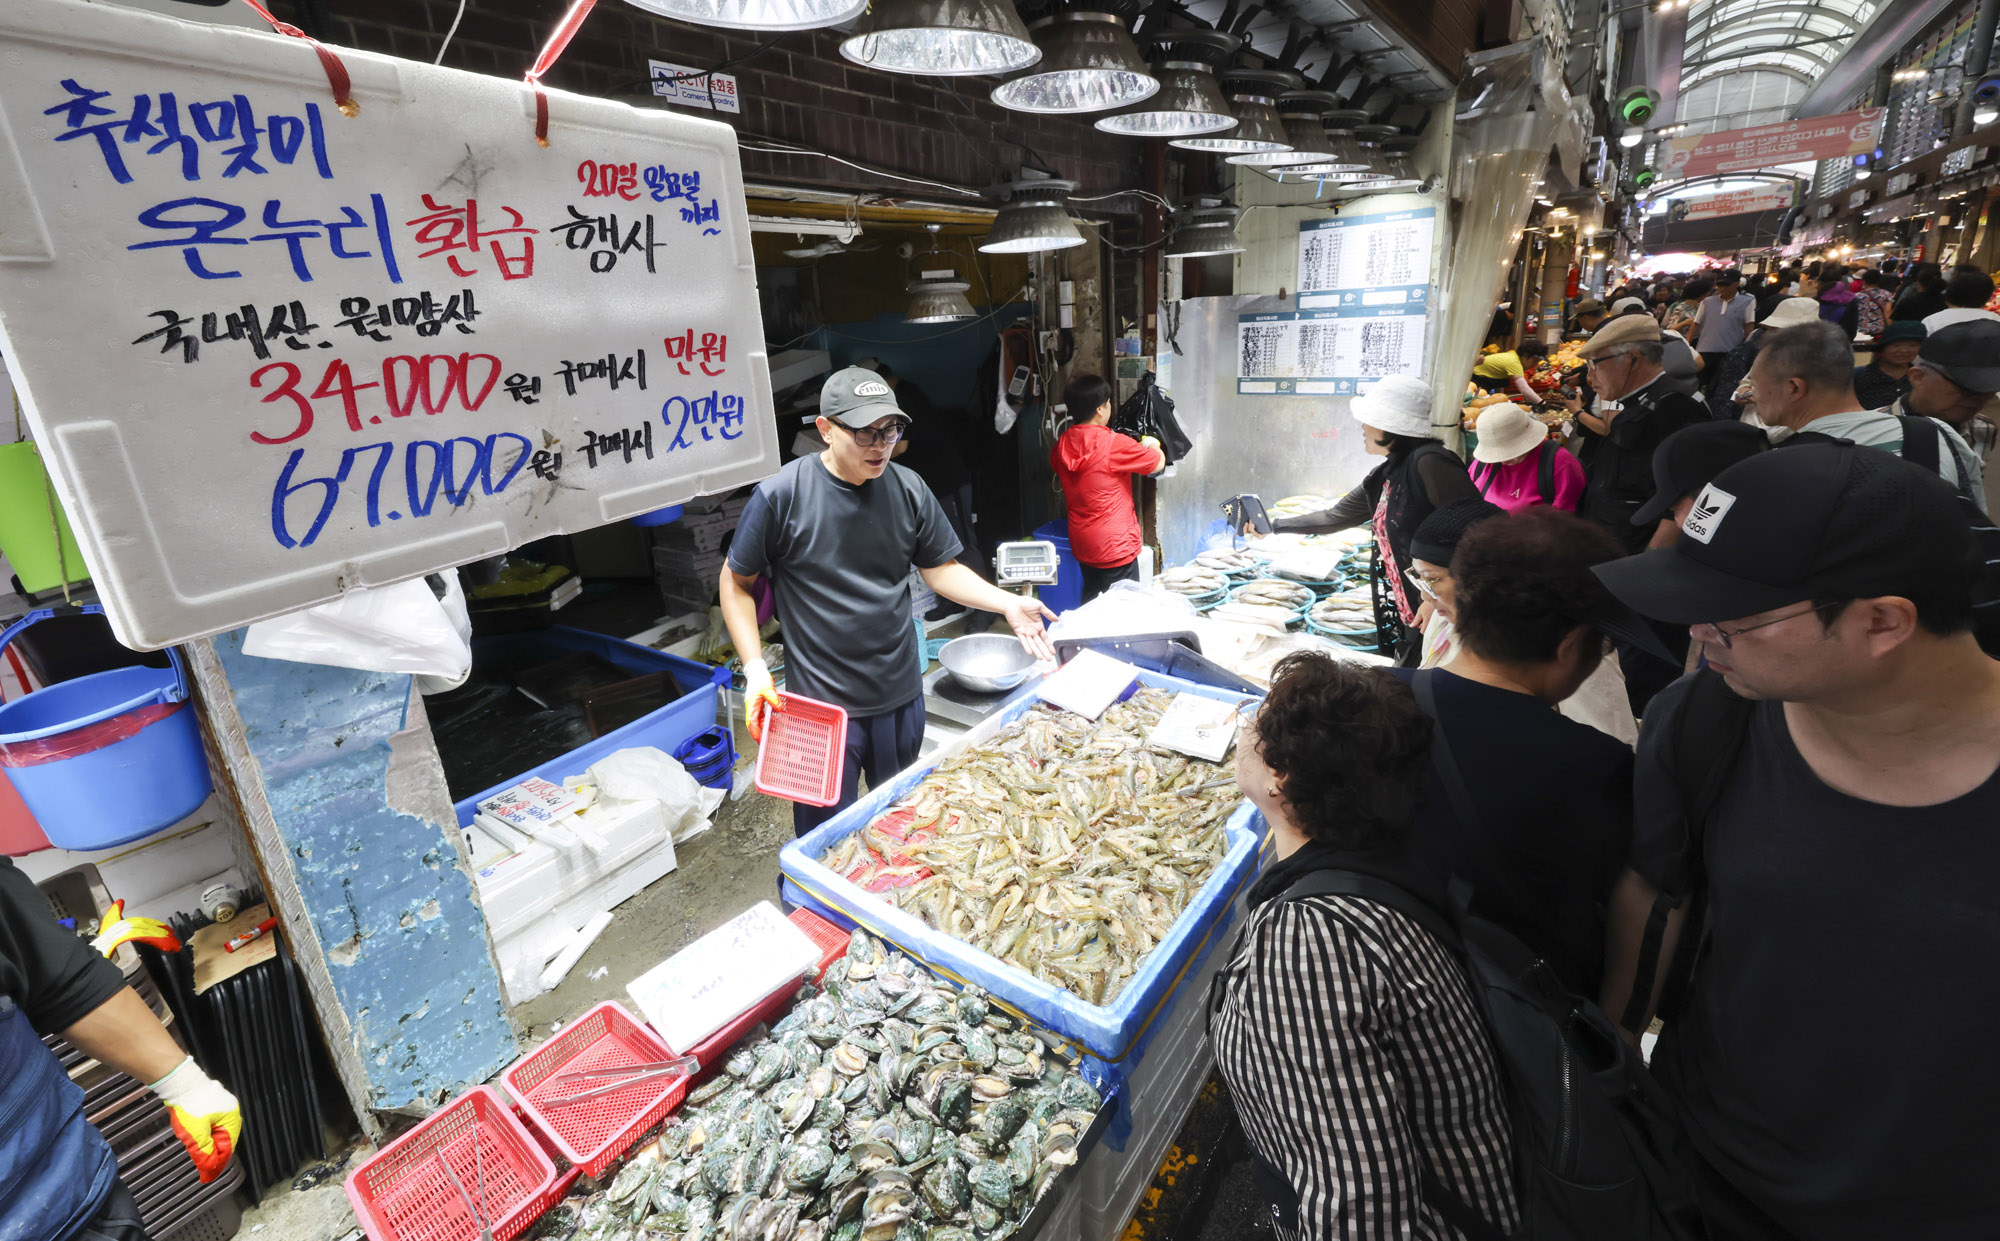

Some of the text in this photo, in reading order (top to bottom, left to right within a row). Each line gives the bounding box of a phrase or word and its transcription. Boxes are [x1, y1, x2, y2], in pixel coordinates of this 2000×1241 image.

[682, 91, 706, 101] Camera
[43, 79, 333, 184] 추석맞이
[577, 160, 641, 201] 20일
[127, 193, 667, 284] 온누리 환급 행사
[250, 328, 727, 444] 34.000 원 구매시 만원
[858, 384, 886, 395] emis
[271, 390, 744, 549] 67.000 원 구매시 2만원
[1509, 488, 1520, 498] A
[219, 910, 233, 921] TOP
